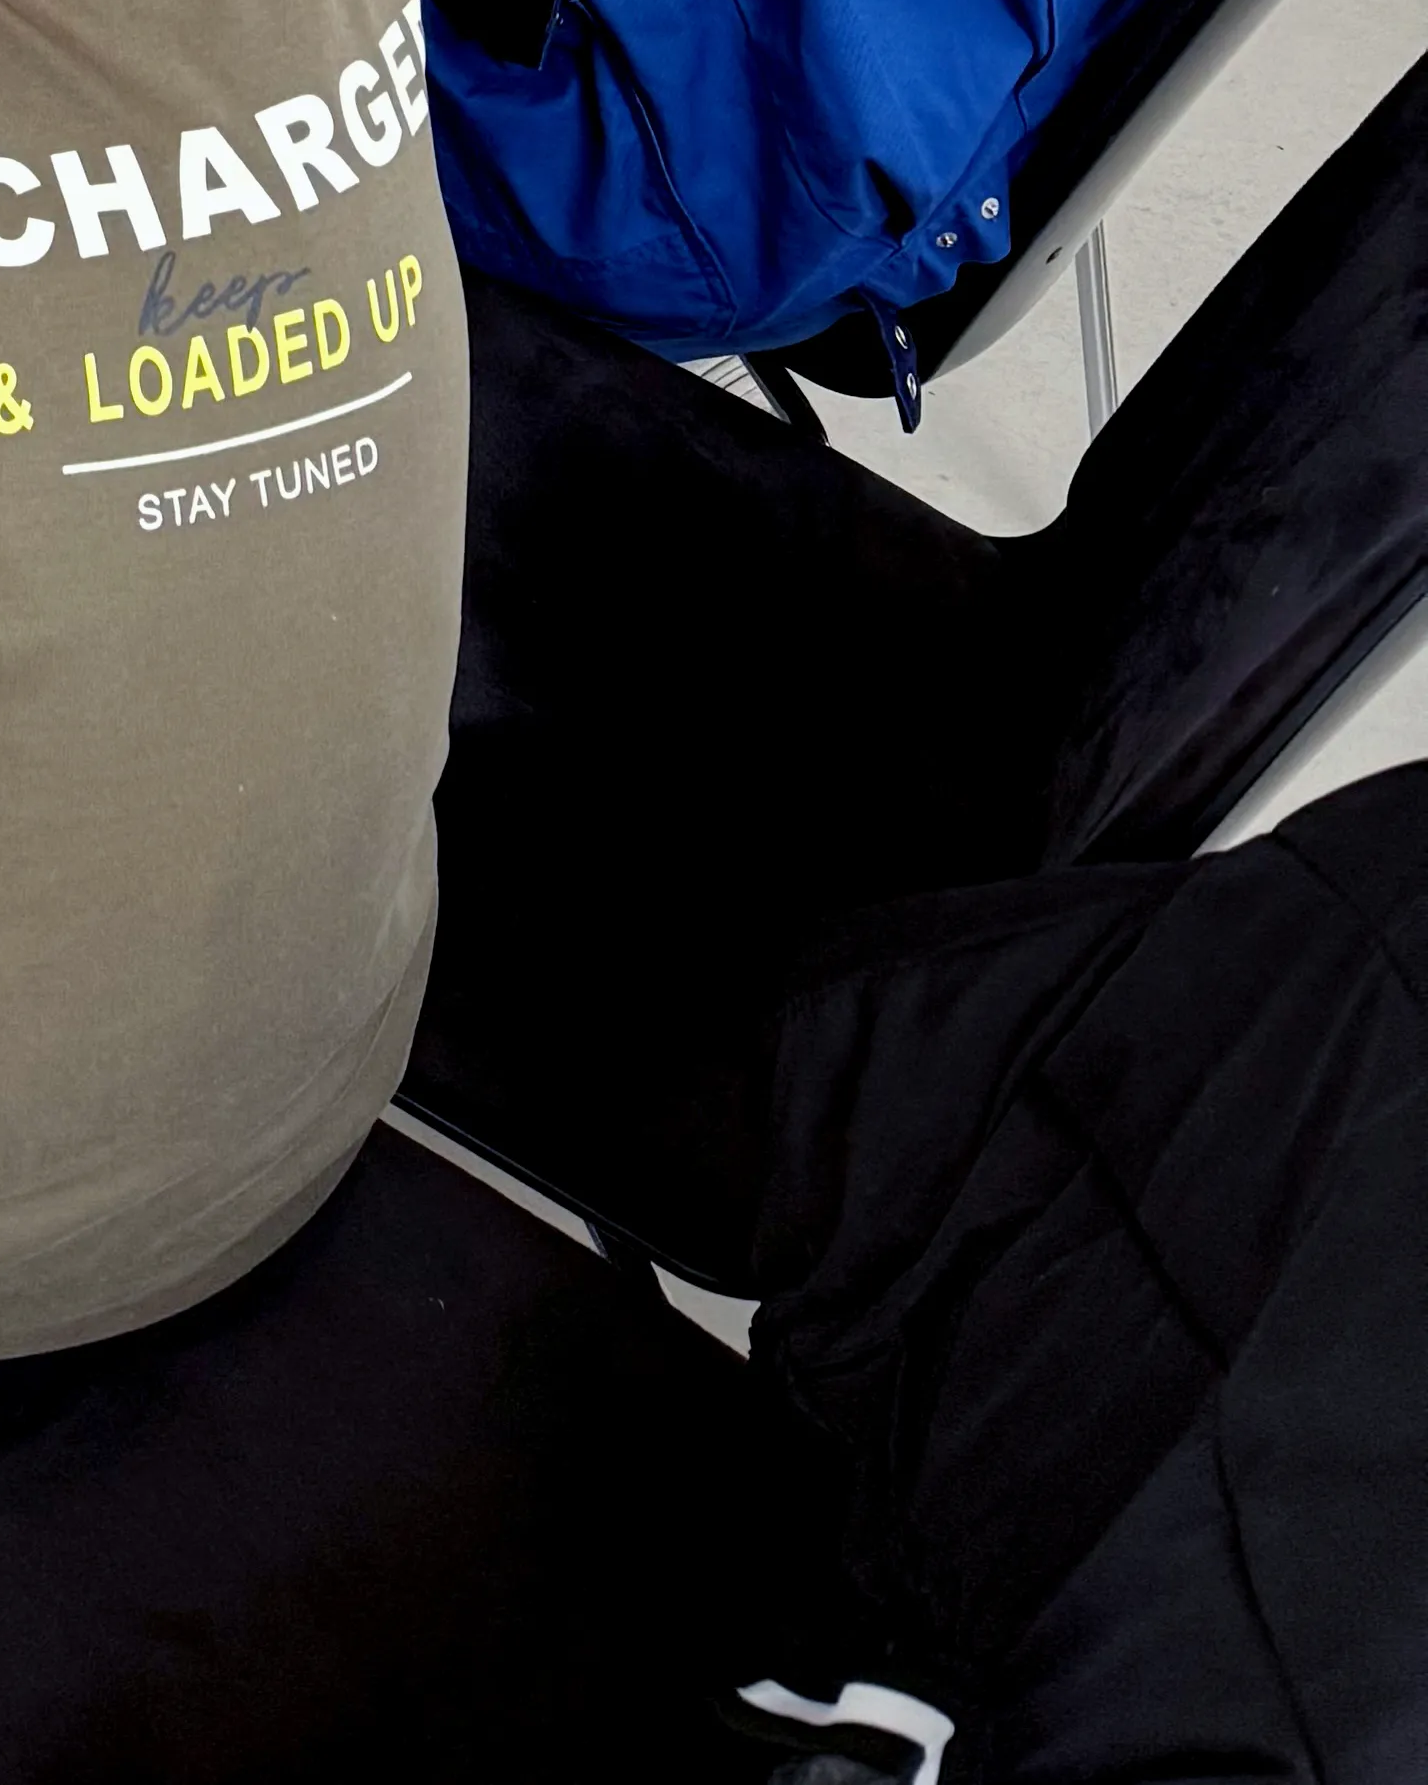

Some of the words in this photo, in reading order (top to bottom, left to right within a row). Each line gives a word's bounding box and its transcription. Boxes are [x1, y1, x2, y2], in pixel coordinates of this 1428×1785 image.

[84, 299, 351, 423] LOADED
[369, 255, 426, 344] UP
[138, 250, 310, 338] keep
[137, 477, 239, 532] STAY
[250, 437, 380, 506] TUNED
